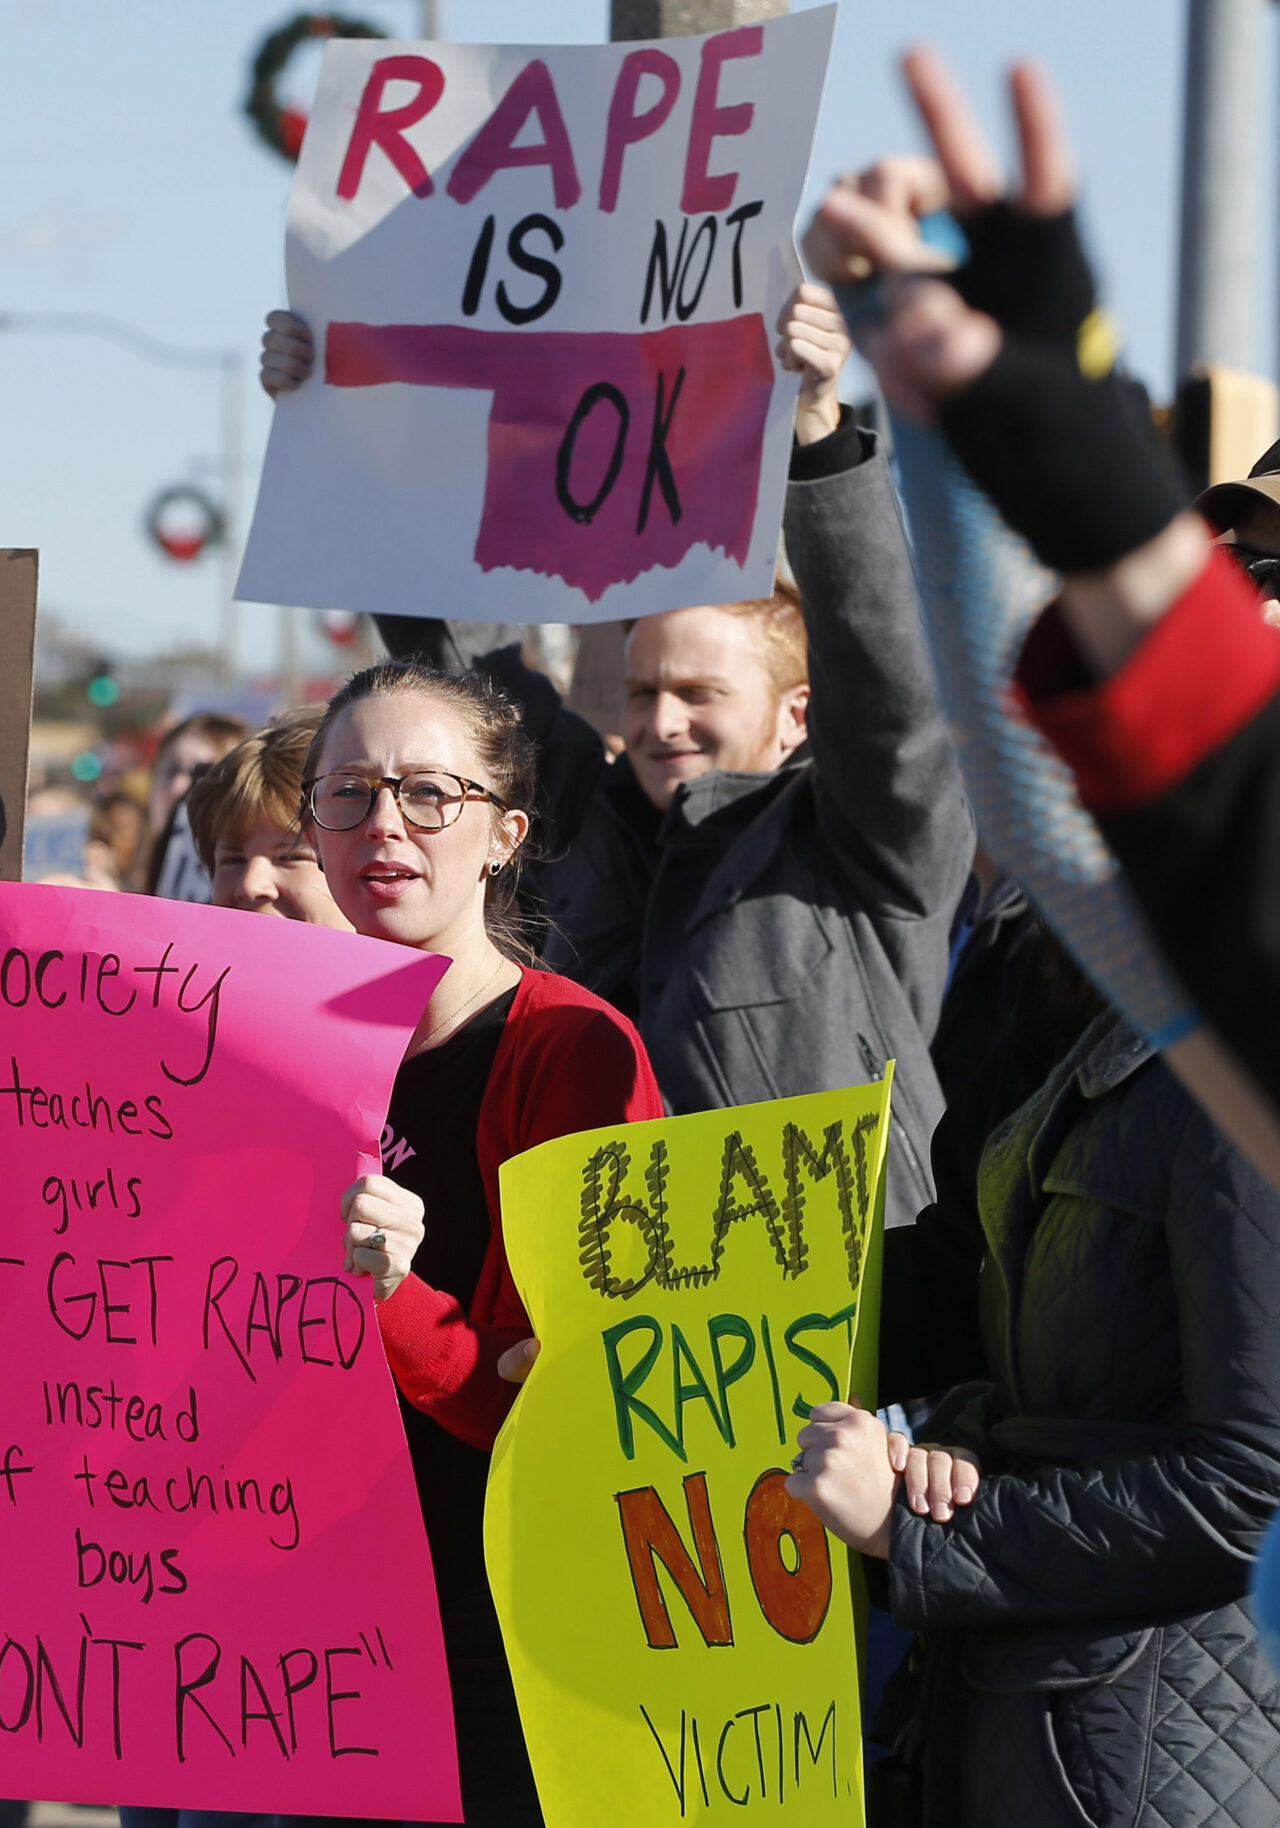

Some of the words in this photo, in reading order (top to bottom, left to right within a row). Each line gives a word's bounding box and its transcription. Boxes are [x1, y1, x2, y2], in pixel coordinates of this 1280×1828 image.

[335, 26, 765, 215] RAPE
[461, 213, 565, 325] IS
[640, 200, 764, 324] NOT
[556, 366, 686, 536] OK
[42, 1168, 142, 1236] girls
[48, 1251, 174, 1346] GET
[203, 1256, 366, 1384] RAPED
[43, 1380, 200, 1443] instead
[74, 1454, 300, 1550] teaching
[612, 1467, 833, 1650] NO
[75, 1528, 188, 1604] boys
